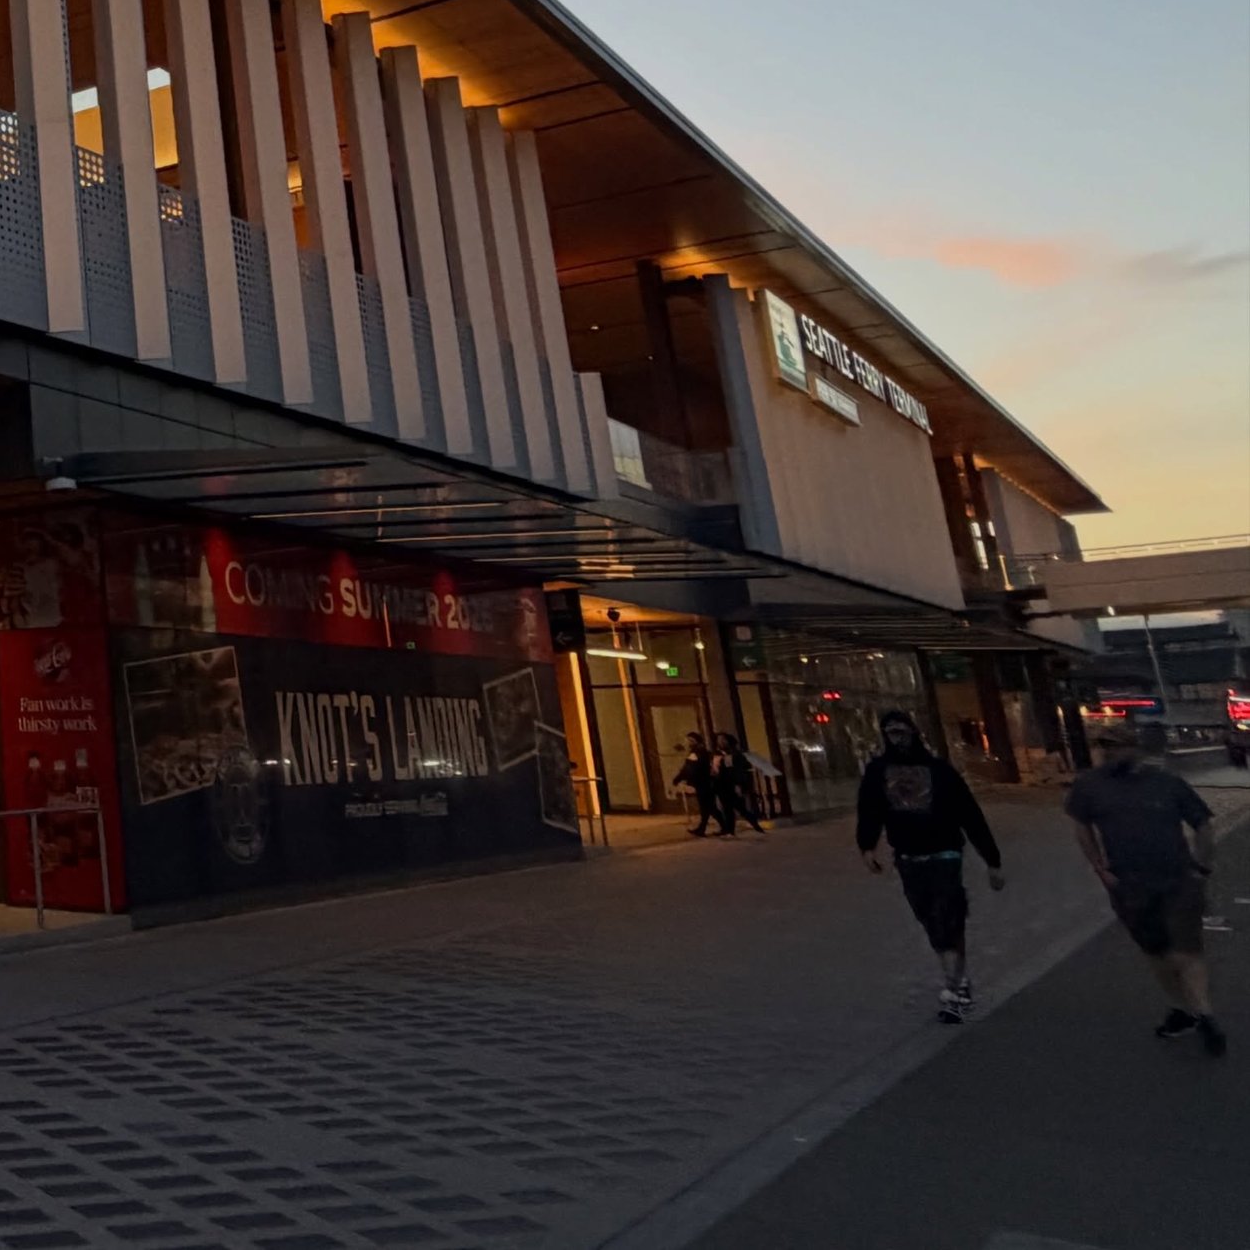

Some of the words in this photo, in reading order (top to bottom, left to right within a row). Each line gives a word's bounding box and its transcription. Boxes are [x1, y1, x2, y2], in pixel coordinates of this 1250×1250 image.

[801, 313, 854, 380] SEATTLE
[852, 351, 886, 403] FERRY
[884, 375, 934, 436] TERMINAL
[225, 561, 334, 615] COMNG
[18, 716, 60, 735] thirsty
[63, 715, 98, 732] work
[20, 696, 44, 713] Fan
[46, 695, 81, 711] work
[81, 695, 94, 711] is
[275, 690, 383, 786] KNOT'S
[385, 694, 489, 781] LANDING
